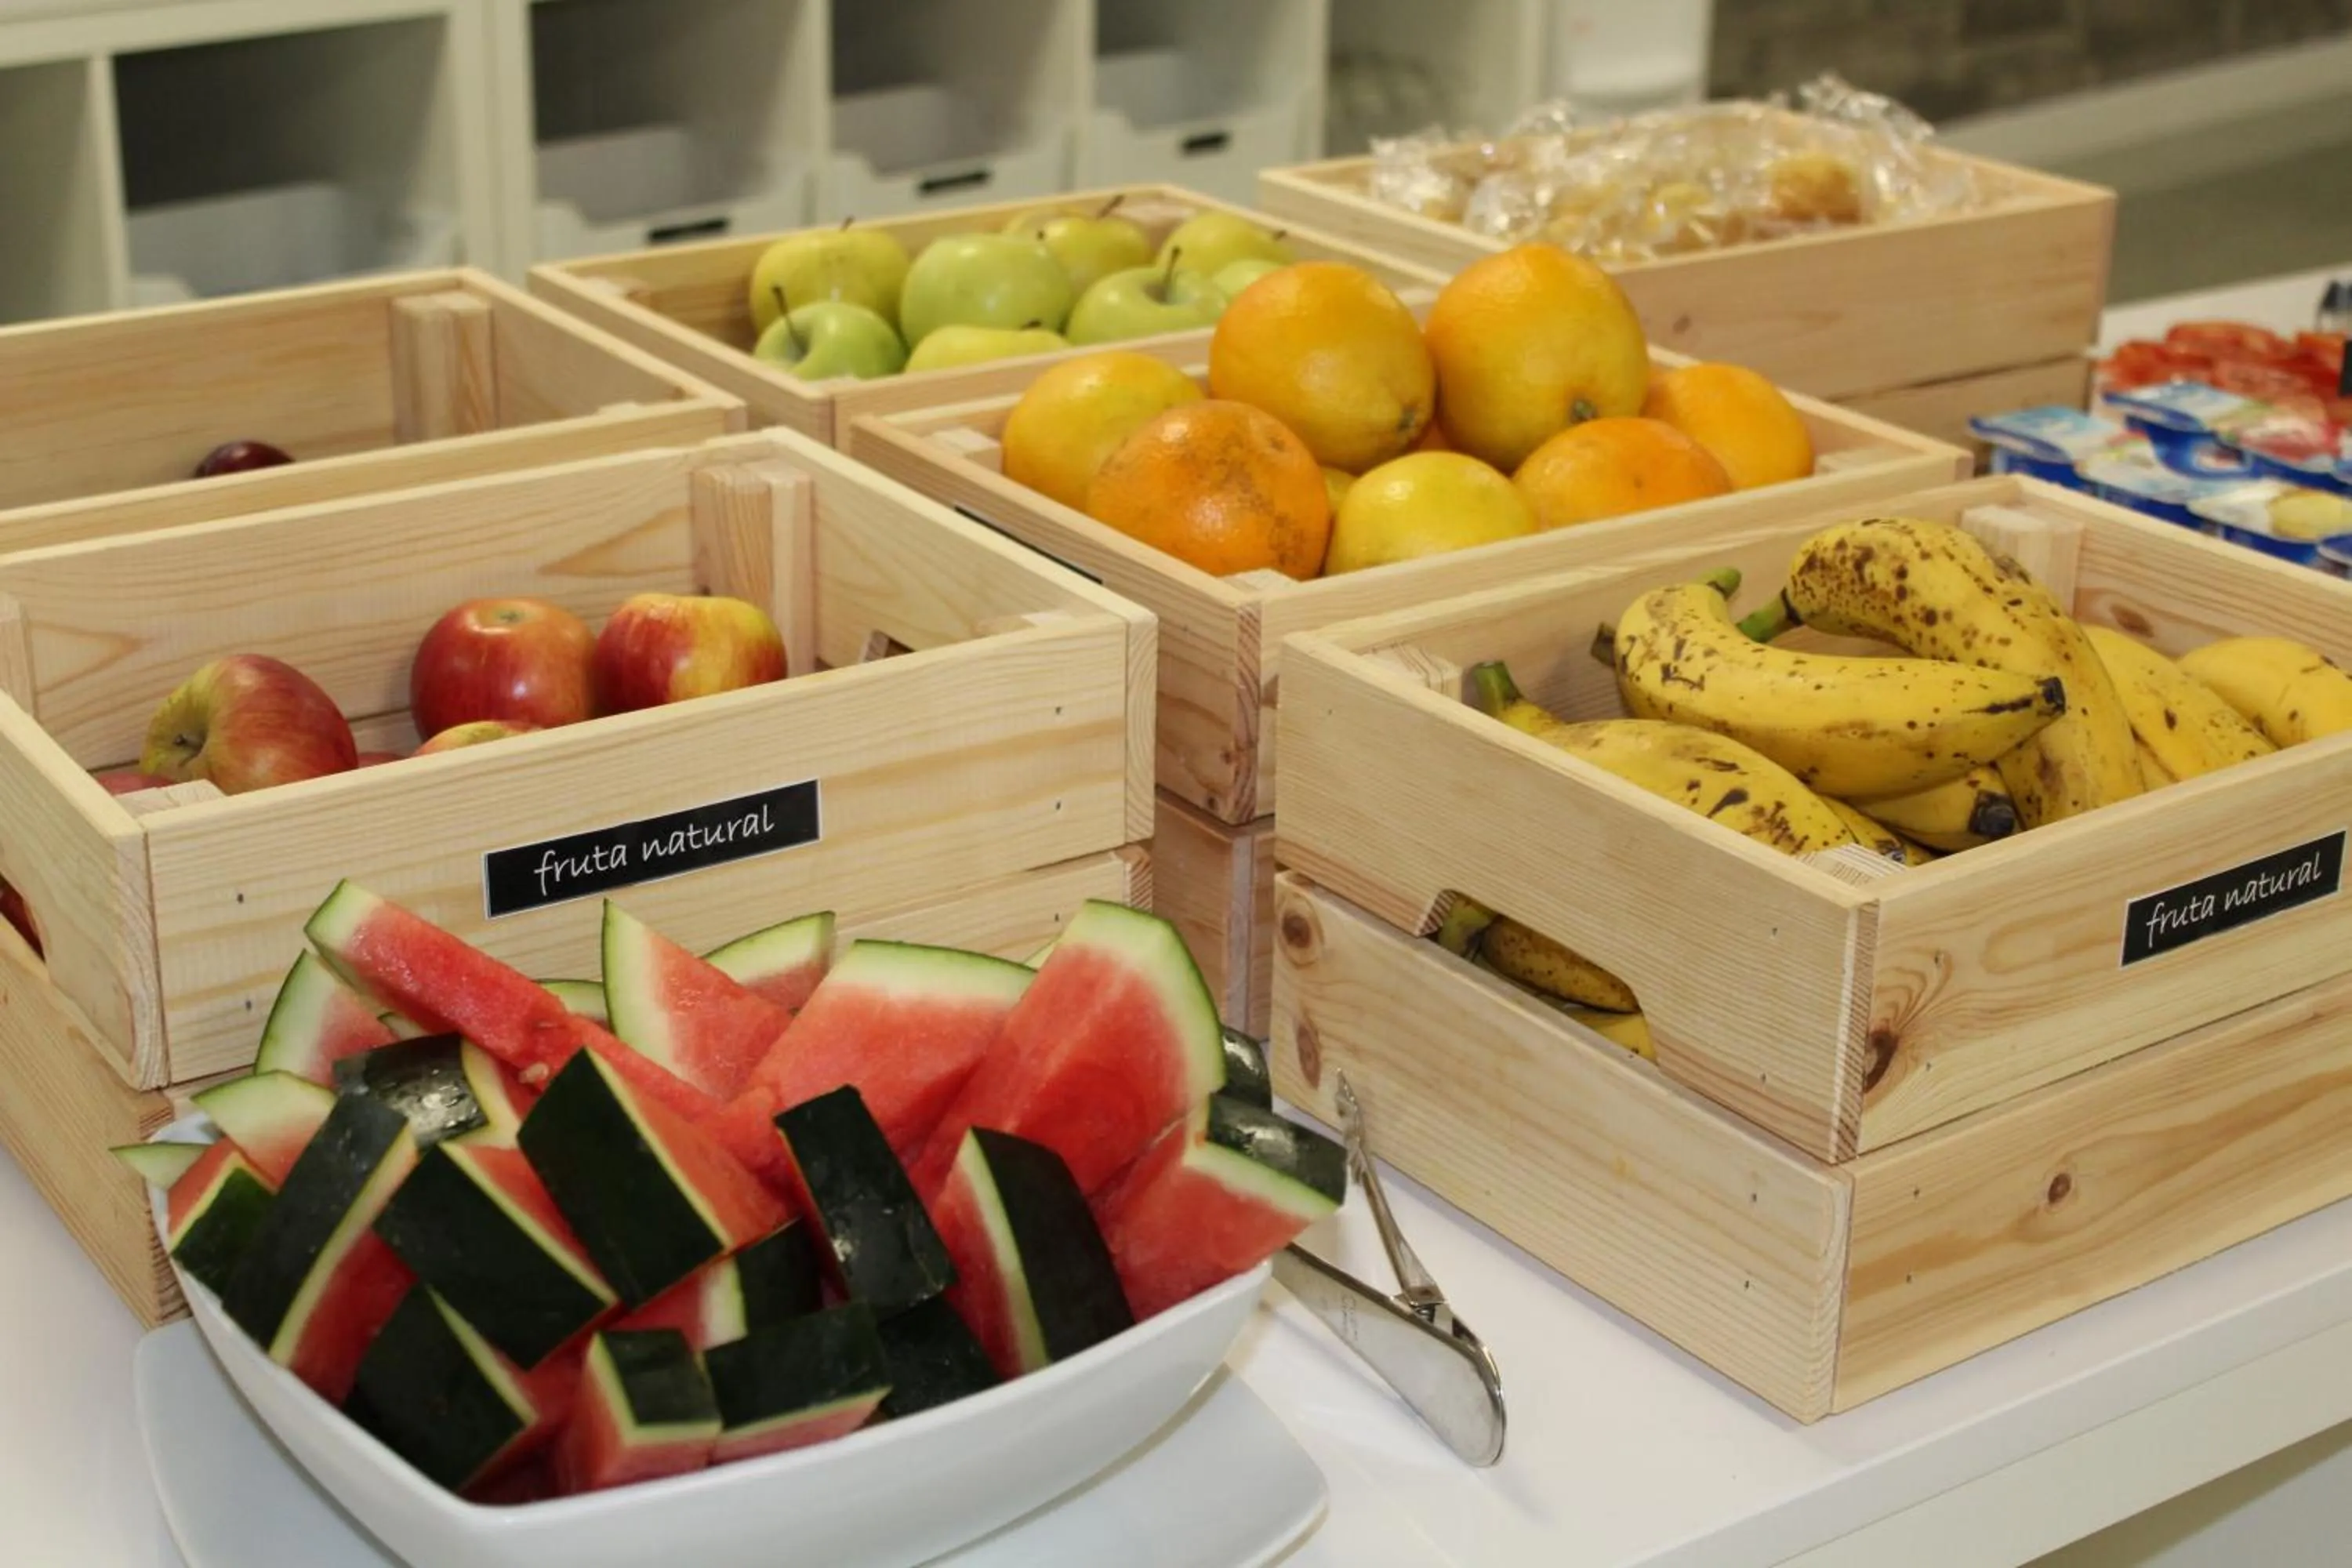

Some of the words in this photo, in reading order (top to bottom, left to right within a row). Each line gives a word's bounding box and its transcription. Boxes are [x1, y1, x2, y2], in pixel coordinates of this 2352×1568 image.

[534, 844, 628, 895] fruta
[642, 804, 775, 862] natural
[2146, 895, 2215, 949] fruta
[2224, 852, 2322, 911] natural
